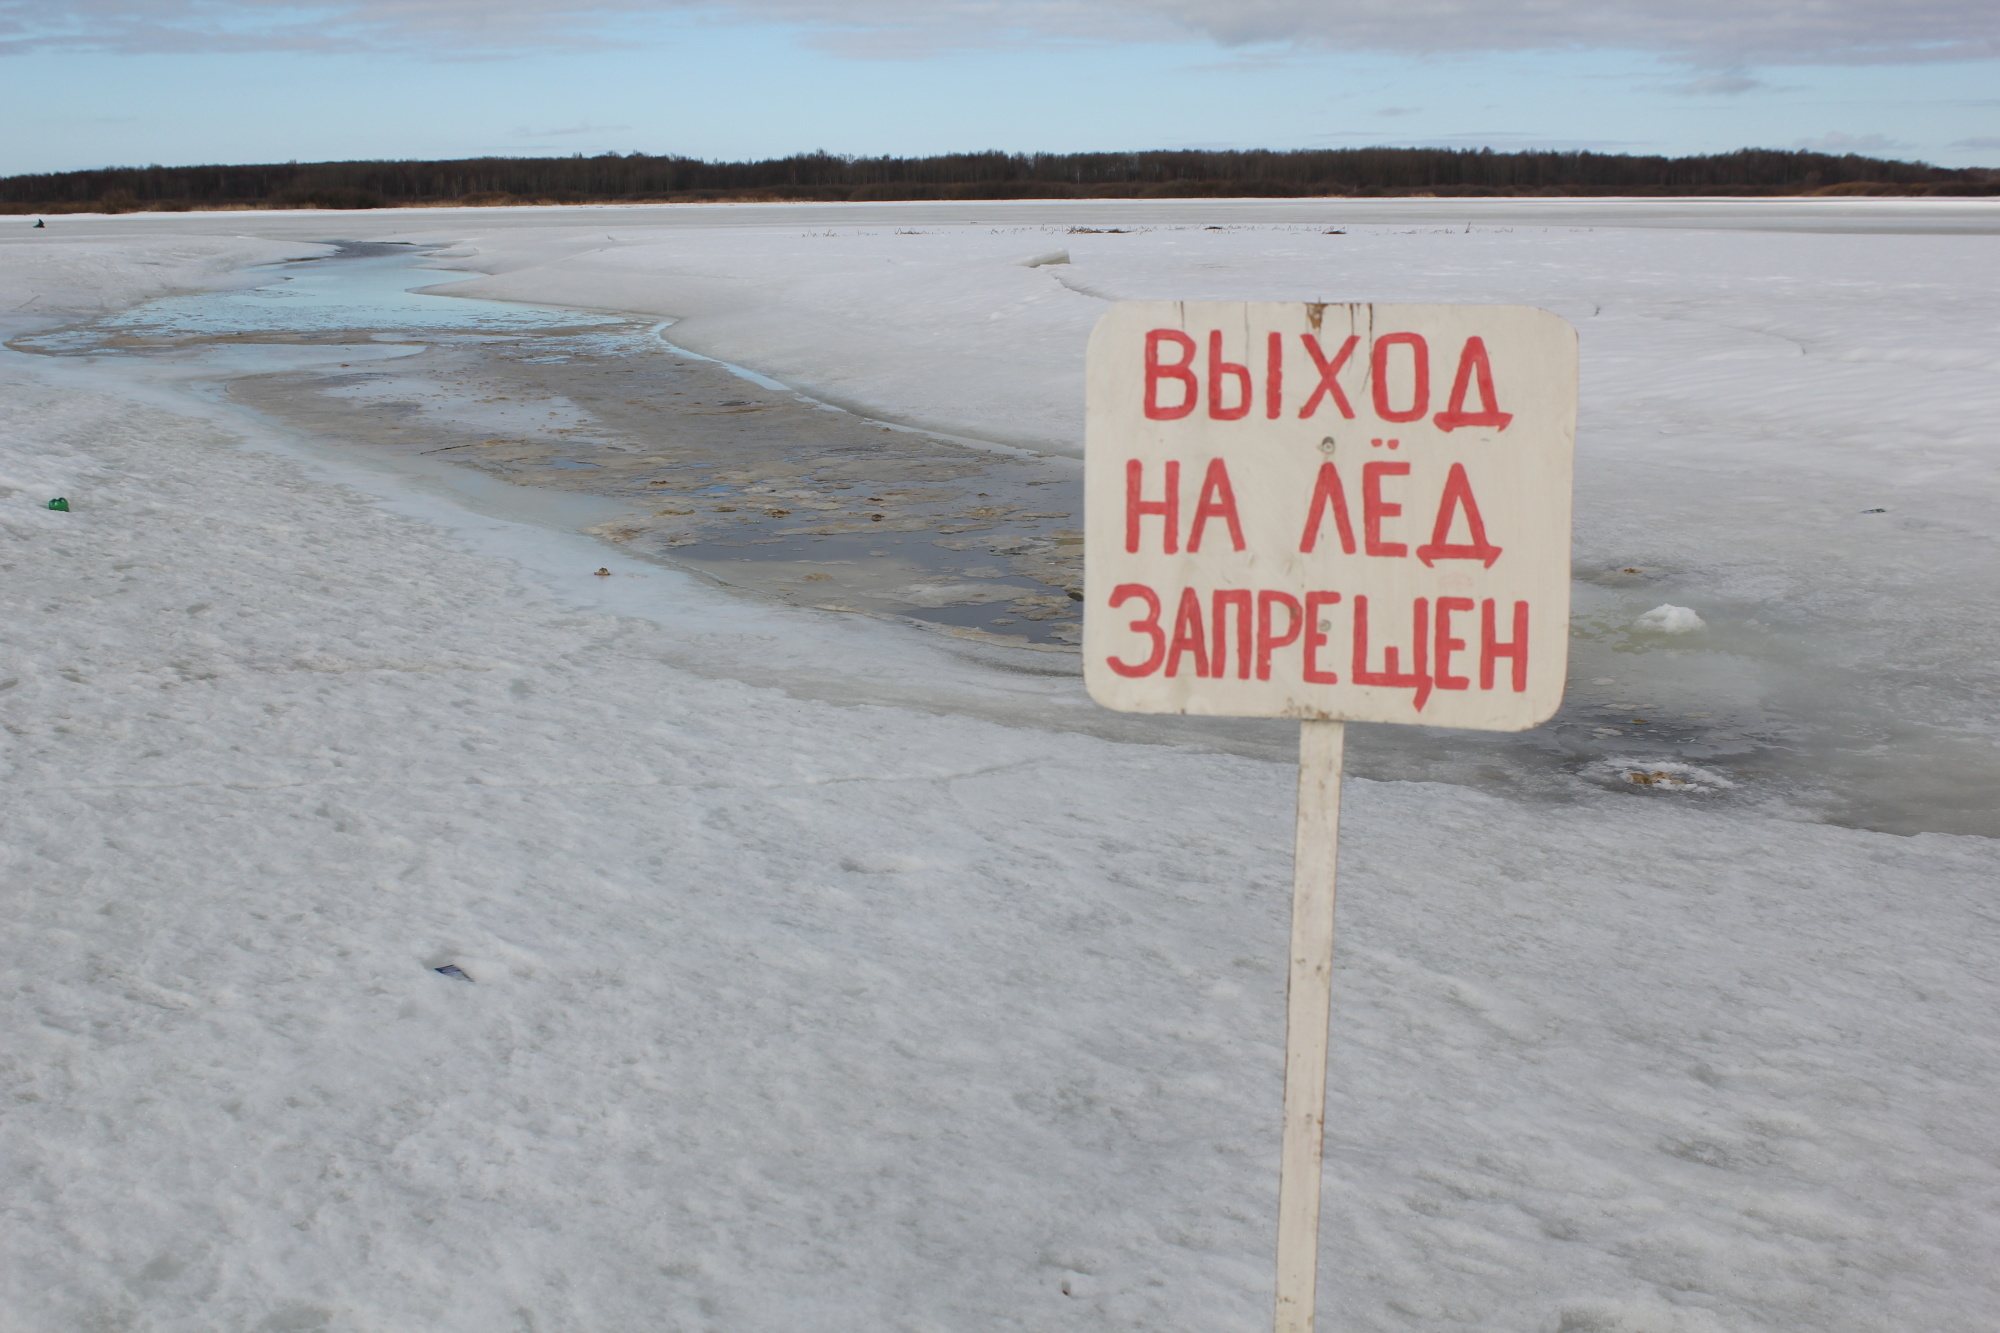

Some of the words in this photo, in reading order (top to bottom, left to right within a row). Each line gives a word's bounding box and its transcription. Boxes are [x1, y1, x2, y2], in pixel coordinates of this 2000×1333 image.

[1143, 328, 1514, 433] ВЫХОД
[1124, 457, 1247, 555] НА
[1299, 438, 1504, 569] ЛЁД
[1106, 582, 1530, 713] ЗАПРЕЩЕН
